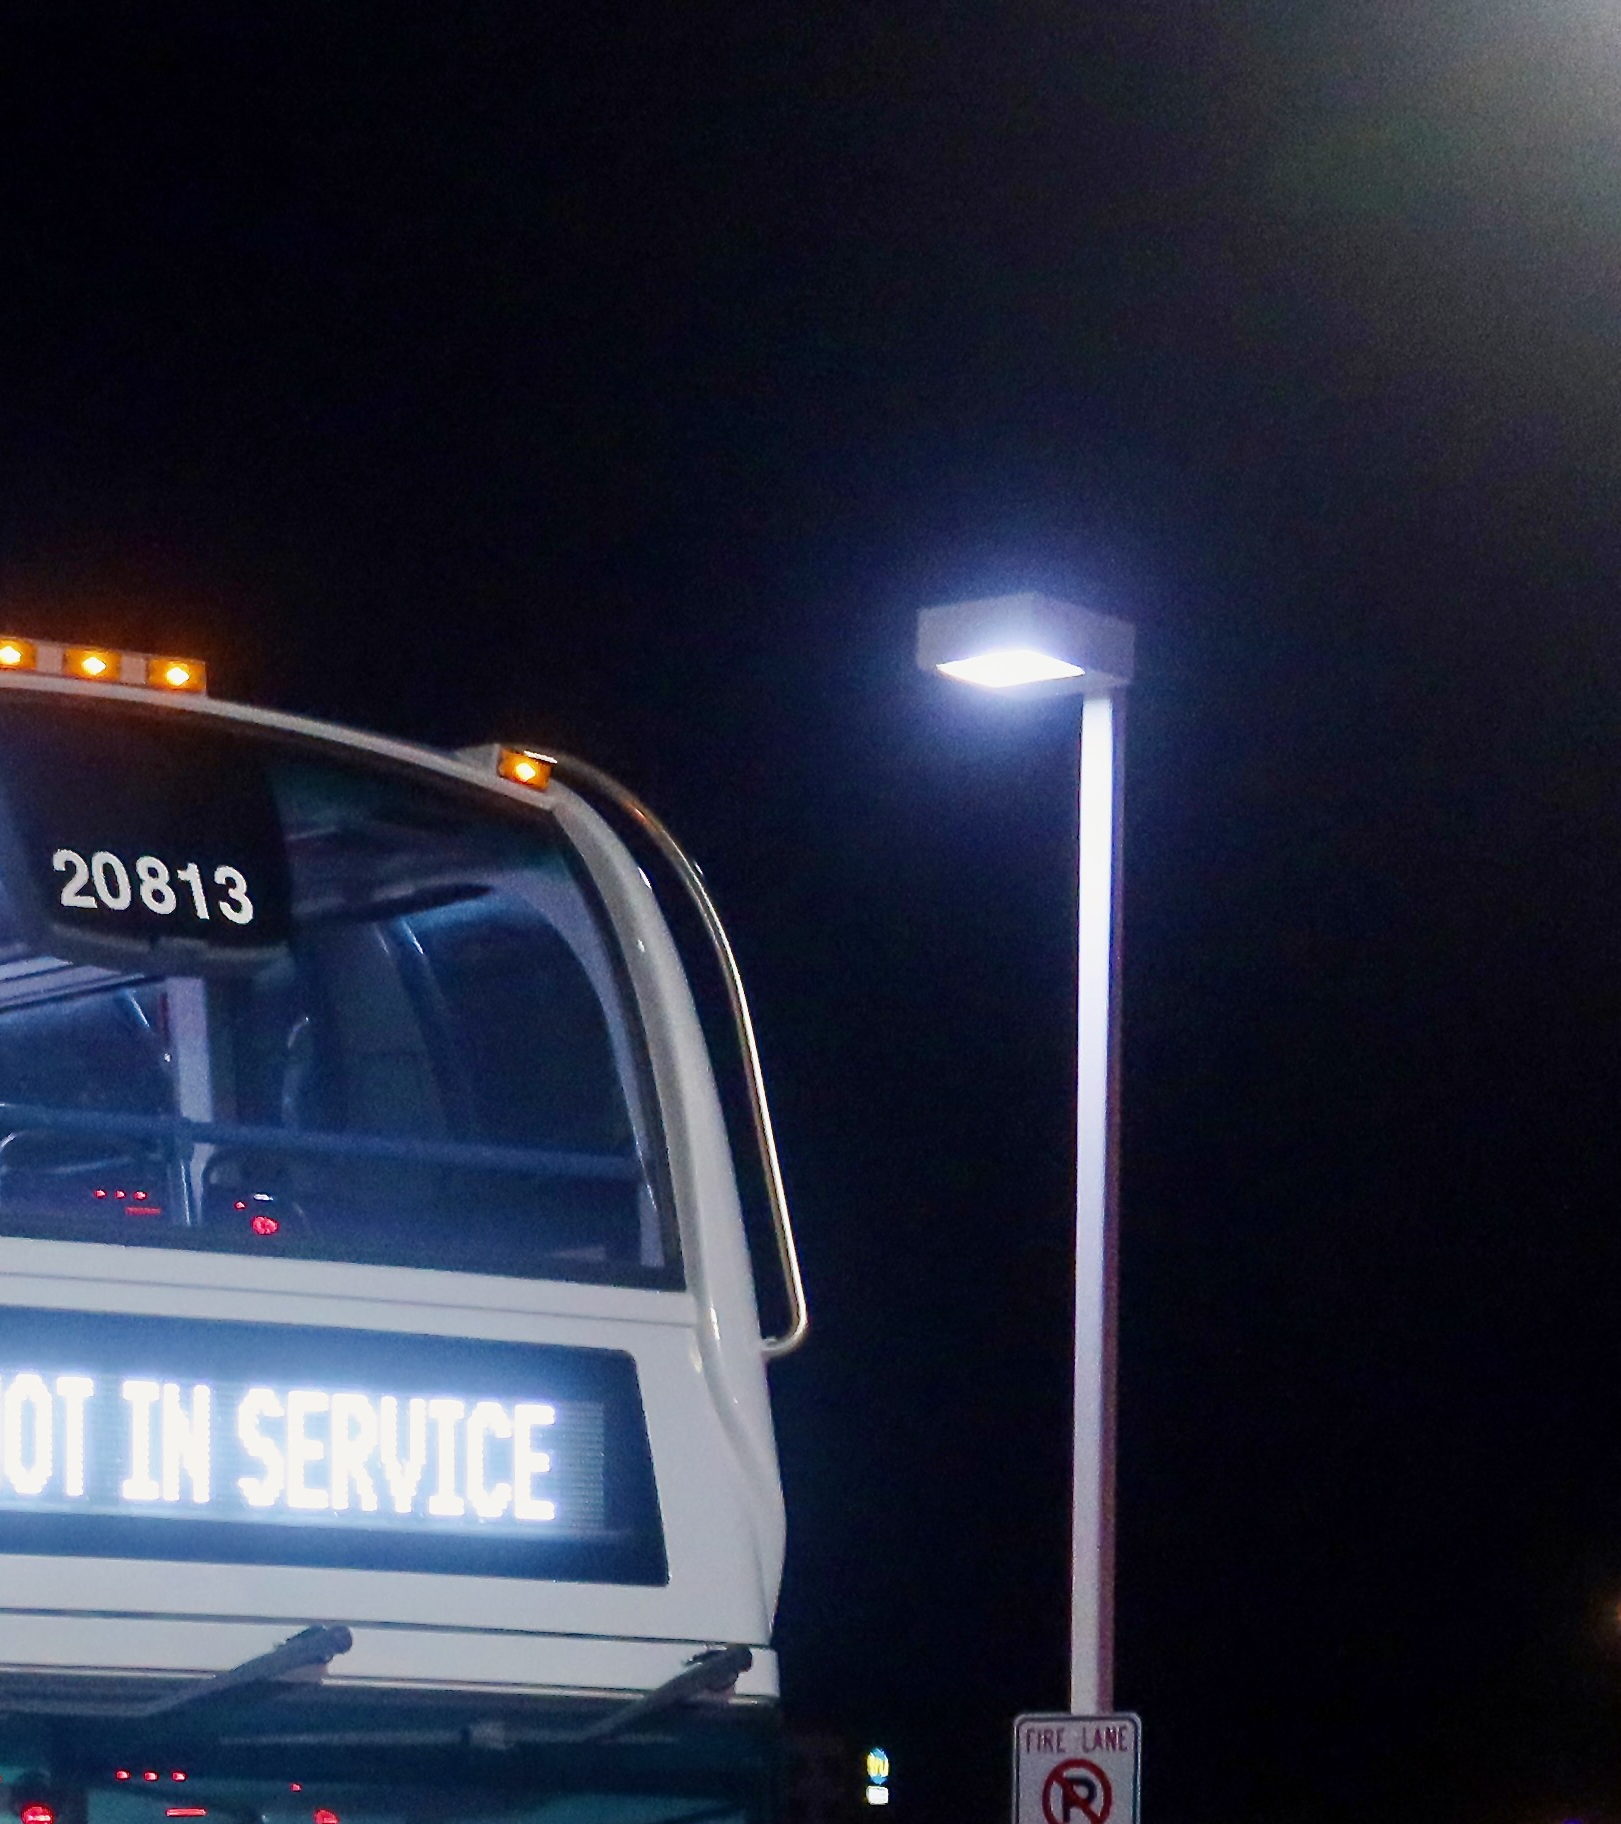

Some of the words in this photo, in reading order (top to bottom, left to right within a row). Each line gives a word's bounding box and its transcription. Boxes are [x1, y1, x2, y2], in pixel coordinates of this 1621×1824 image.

[53, 849, 254, 925] 20813
[123, 1380, 210, 1503] IN
[239, 1388, 556, 1521] SERVICE
[1026, 1728, 1066, 1753] FIRE
[1082, 1725, 1128, 1753] LANE
